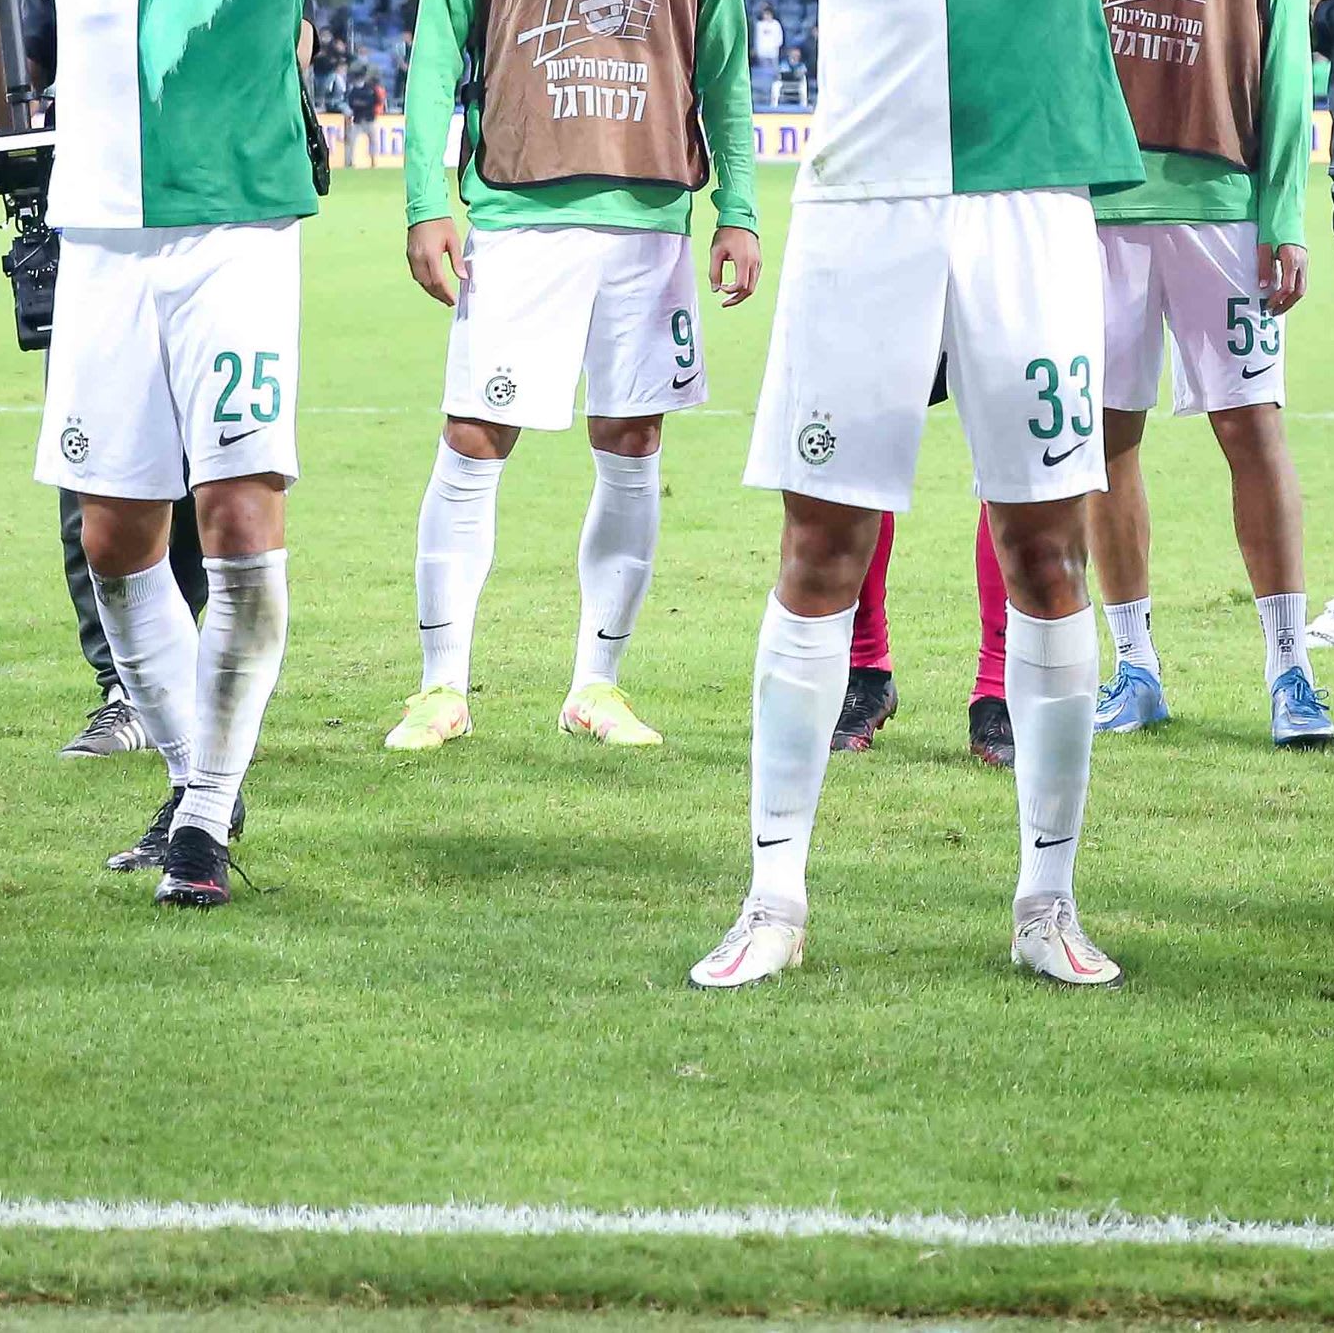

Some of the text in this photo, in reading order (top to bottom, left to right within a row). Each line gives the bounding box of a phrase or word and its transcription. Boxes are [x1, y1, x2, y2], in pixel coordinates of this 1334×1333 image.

[1112, 6, 1158, 30] הליגות
[545, 54, 648, 83] מנהלת הליגות
[1110, 25, 1201, 66] לכדורגל
[547, 82, 647, 122] לכדורגל
[671, 309, 695, 368] 9
[1227, 297, 1280, 356] 55
[213, 351, 281, 423] 25
[1025, 355, 1094, 439] 33
